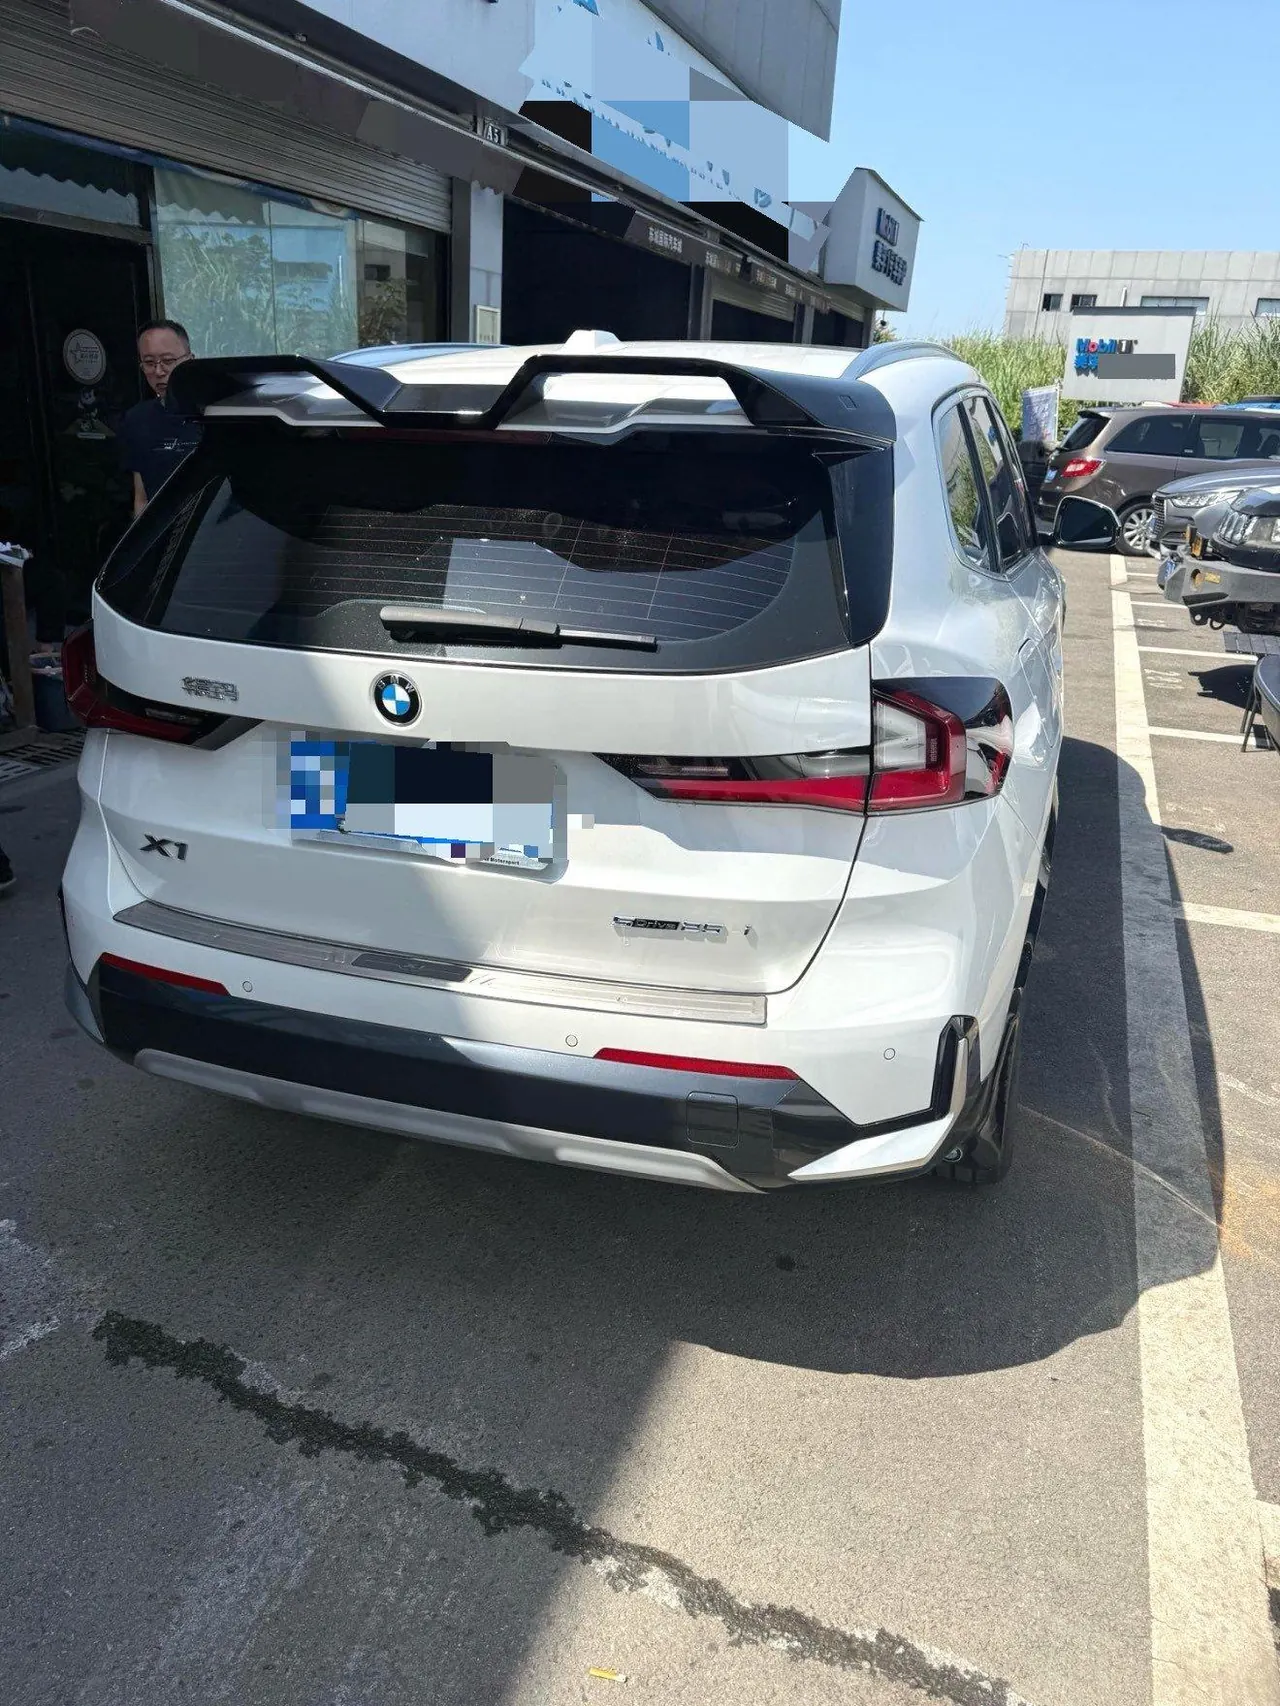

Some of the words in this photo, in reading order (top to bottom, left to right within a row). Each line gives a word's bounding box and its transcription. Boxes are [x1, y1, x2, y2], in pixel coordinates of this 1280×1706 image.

[487, 126, 498, 143] A5
[1076, 338, 1117, 354] Mobil
[377, 675, 415, 694] BMW
[140, 834, 188, 861] X1
